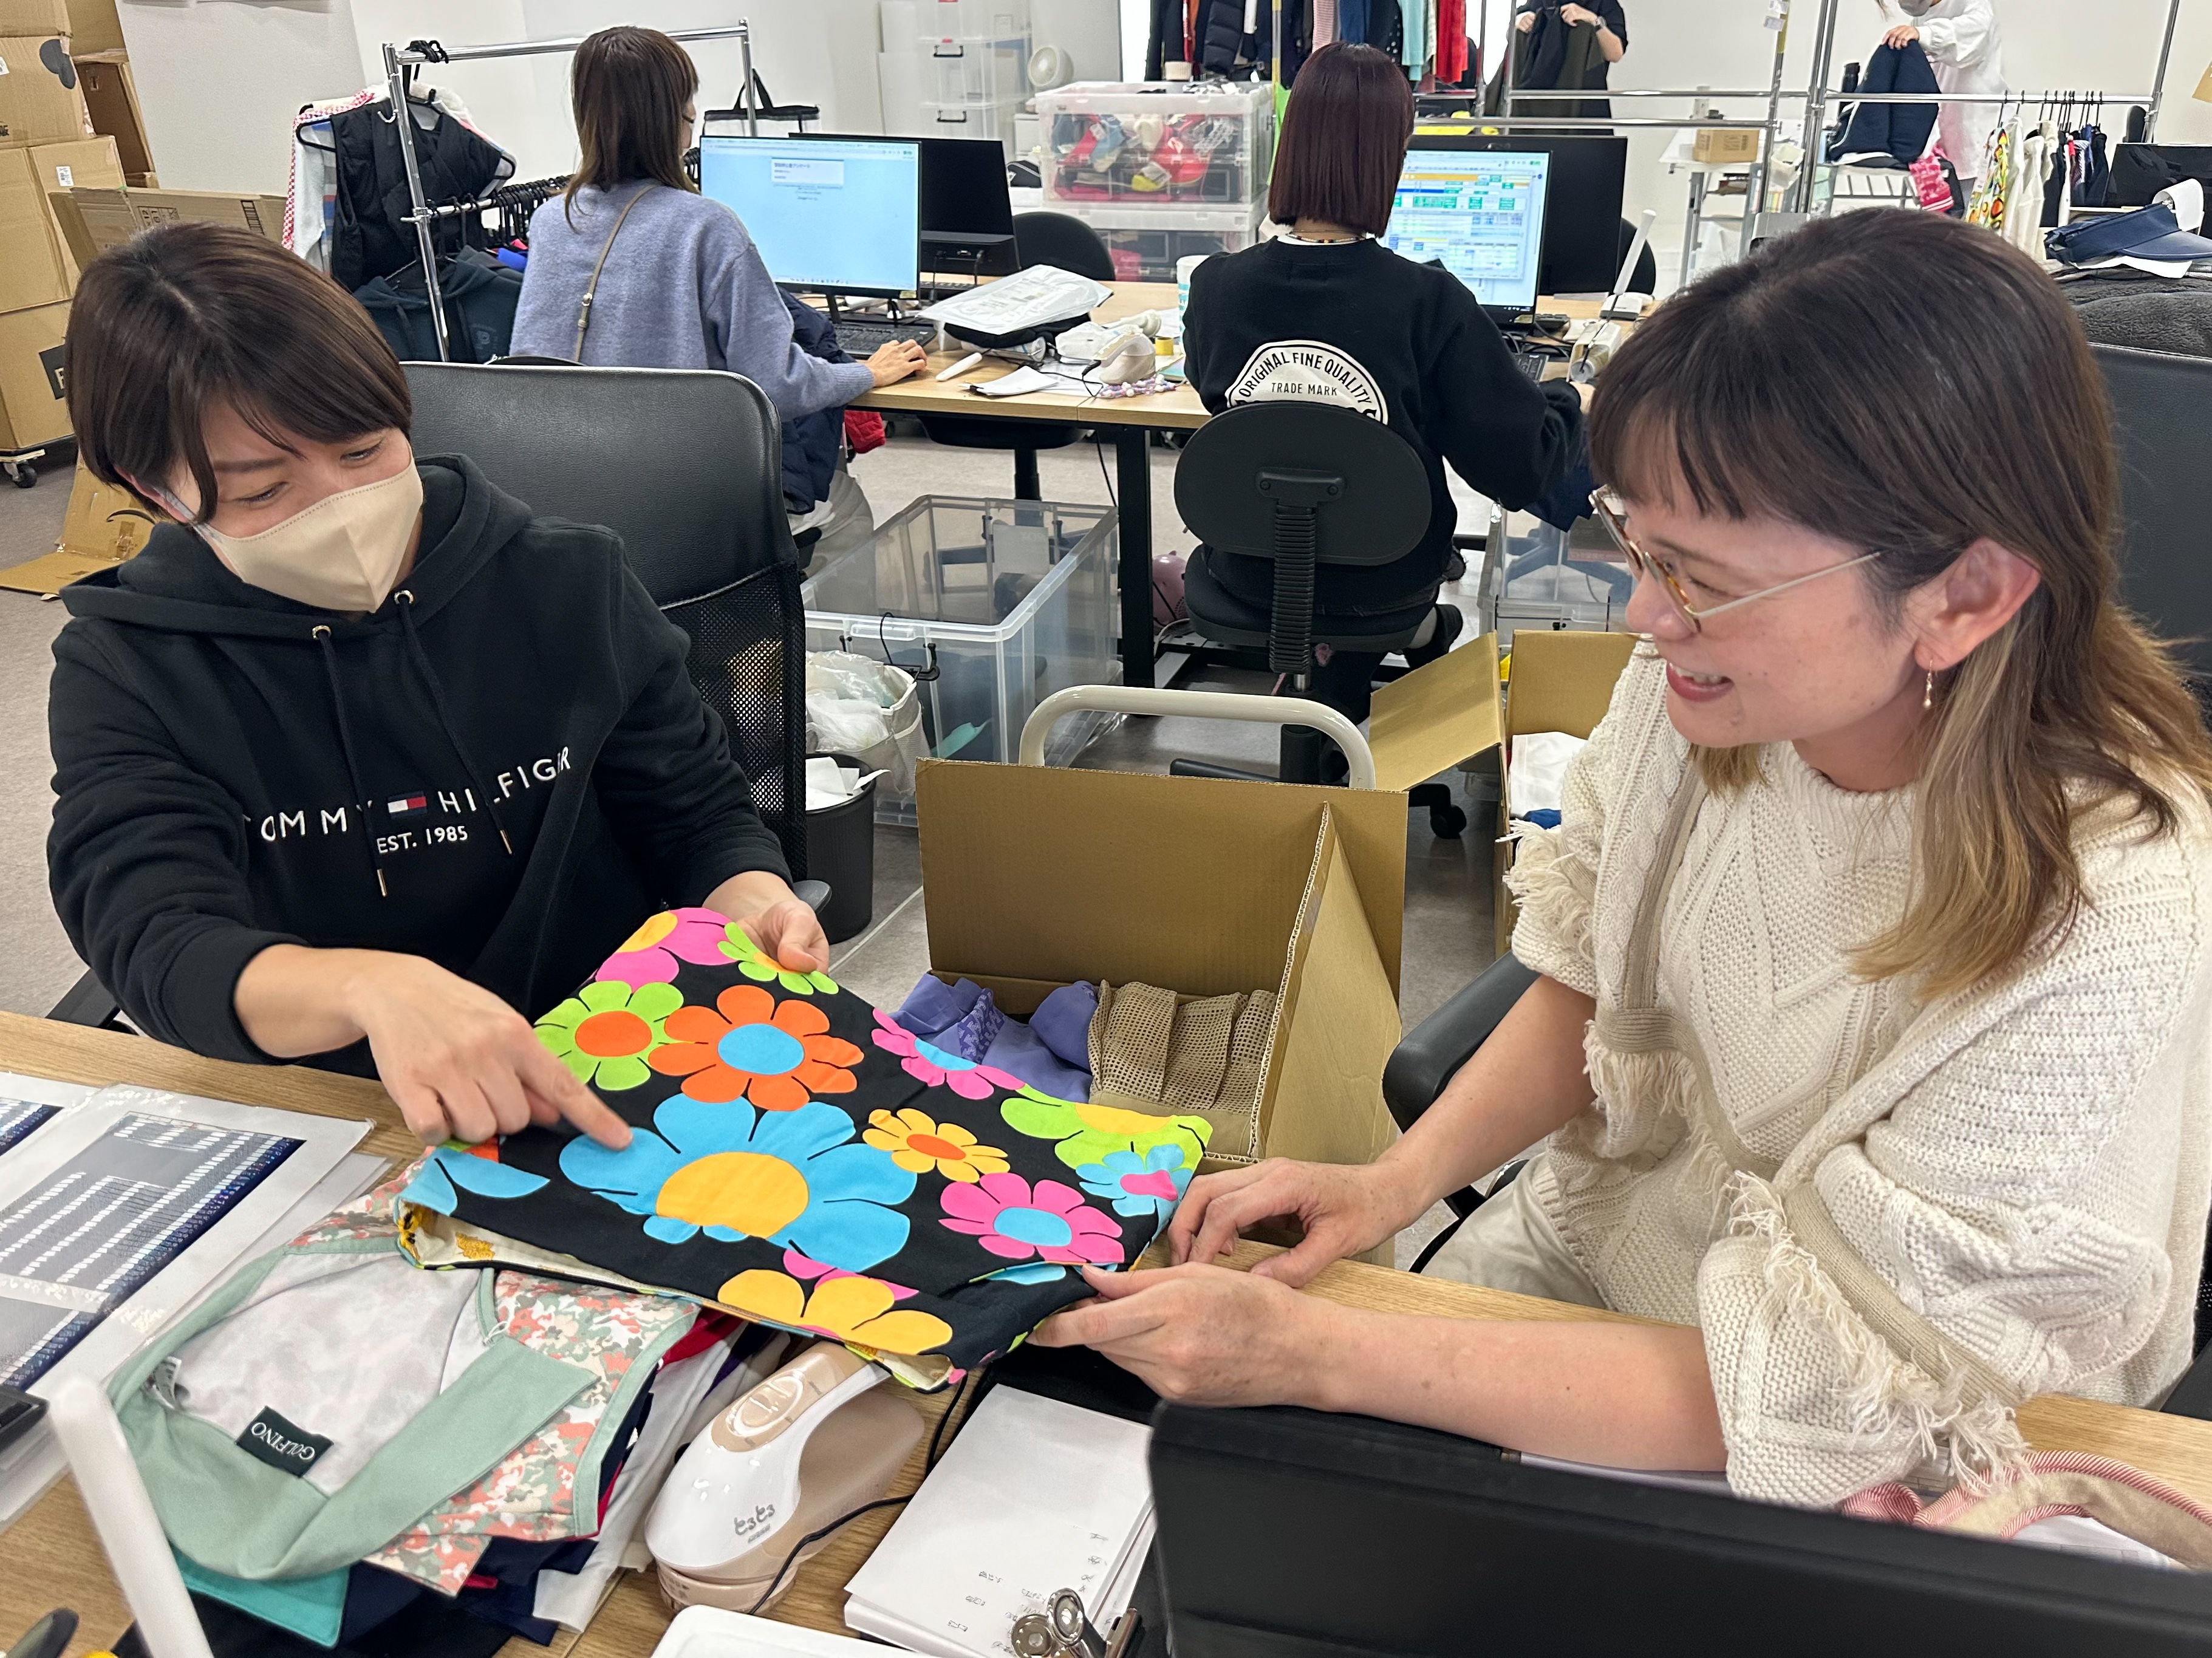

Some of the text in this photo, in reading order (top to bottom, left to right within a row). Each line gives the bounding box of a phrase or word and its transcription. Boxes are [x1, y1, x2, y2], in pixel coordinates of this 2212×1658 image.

[1238, 352, 1372, 403] ORIGINAL FINE QUALITY
[1271, 382, 1337, 396] TRADE MARK
[243, 800, 373, 842] OMM
[377, 825, 468, 854] EST. 1985
